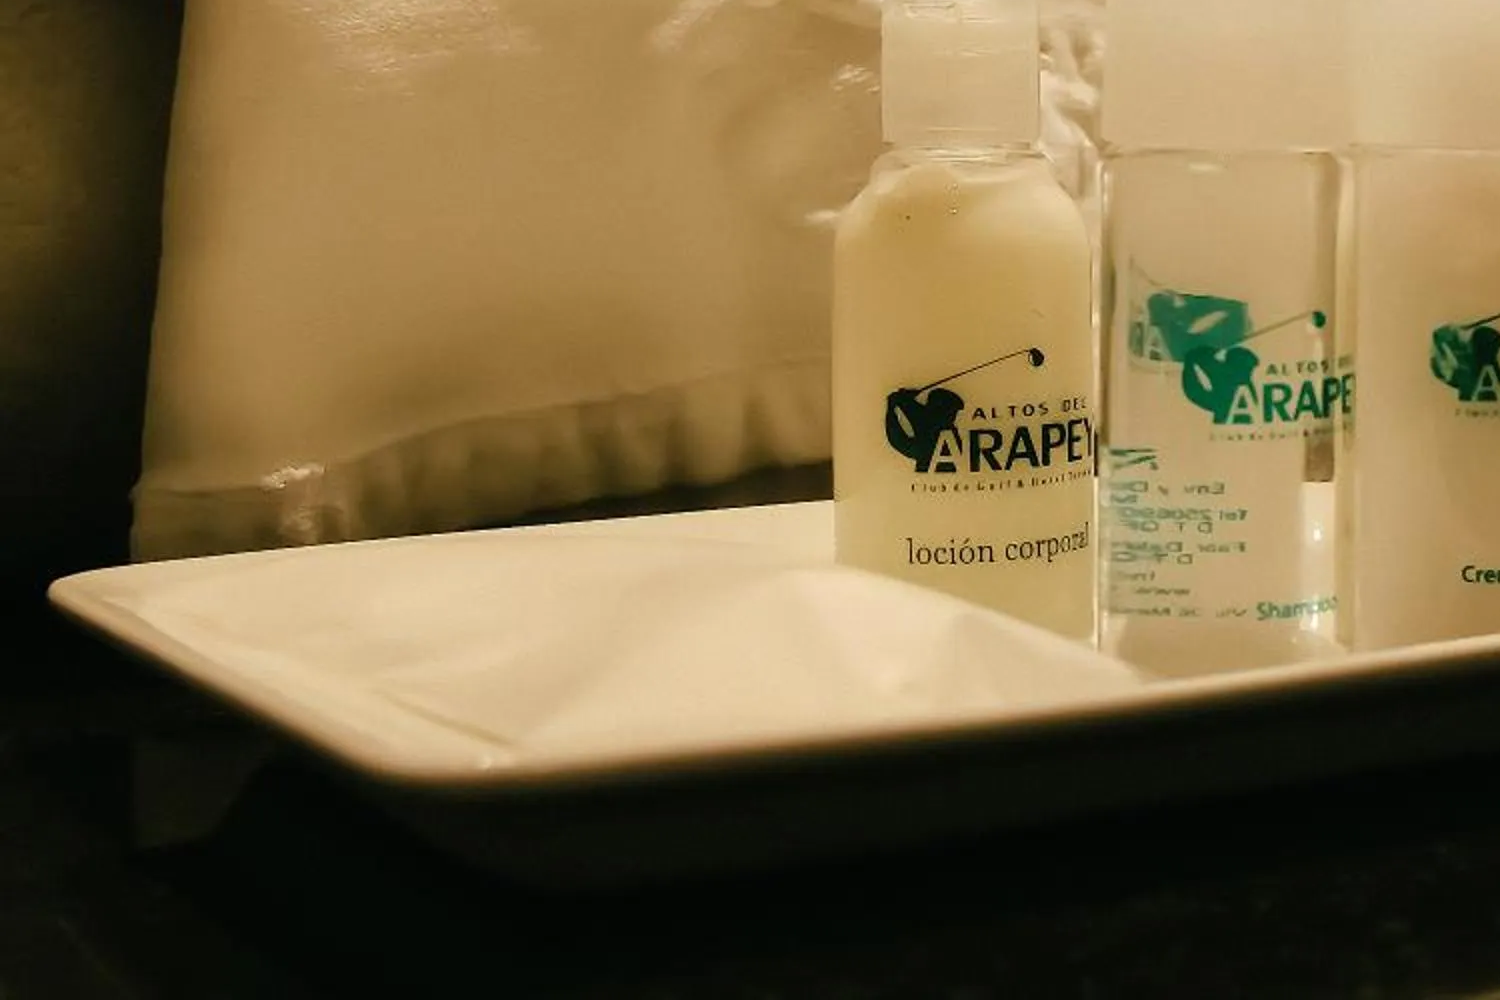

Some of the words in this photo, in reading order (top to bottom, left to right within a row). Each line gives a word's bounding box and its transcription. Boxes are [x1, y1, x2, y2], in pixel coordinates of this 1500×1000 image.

[972, 404, 1049, 421] ALTOS
[1228, 373, 1357, 425] ARAPE
[906, 537, 995, 565] loción
